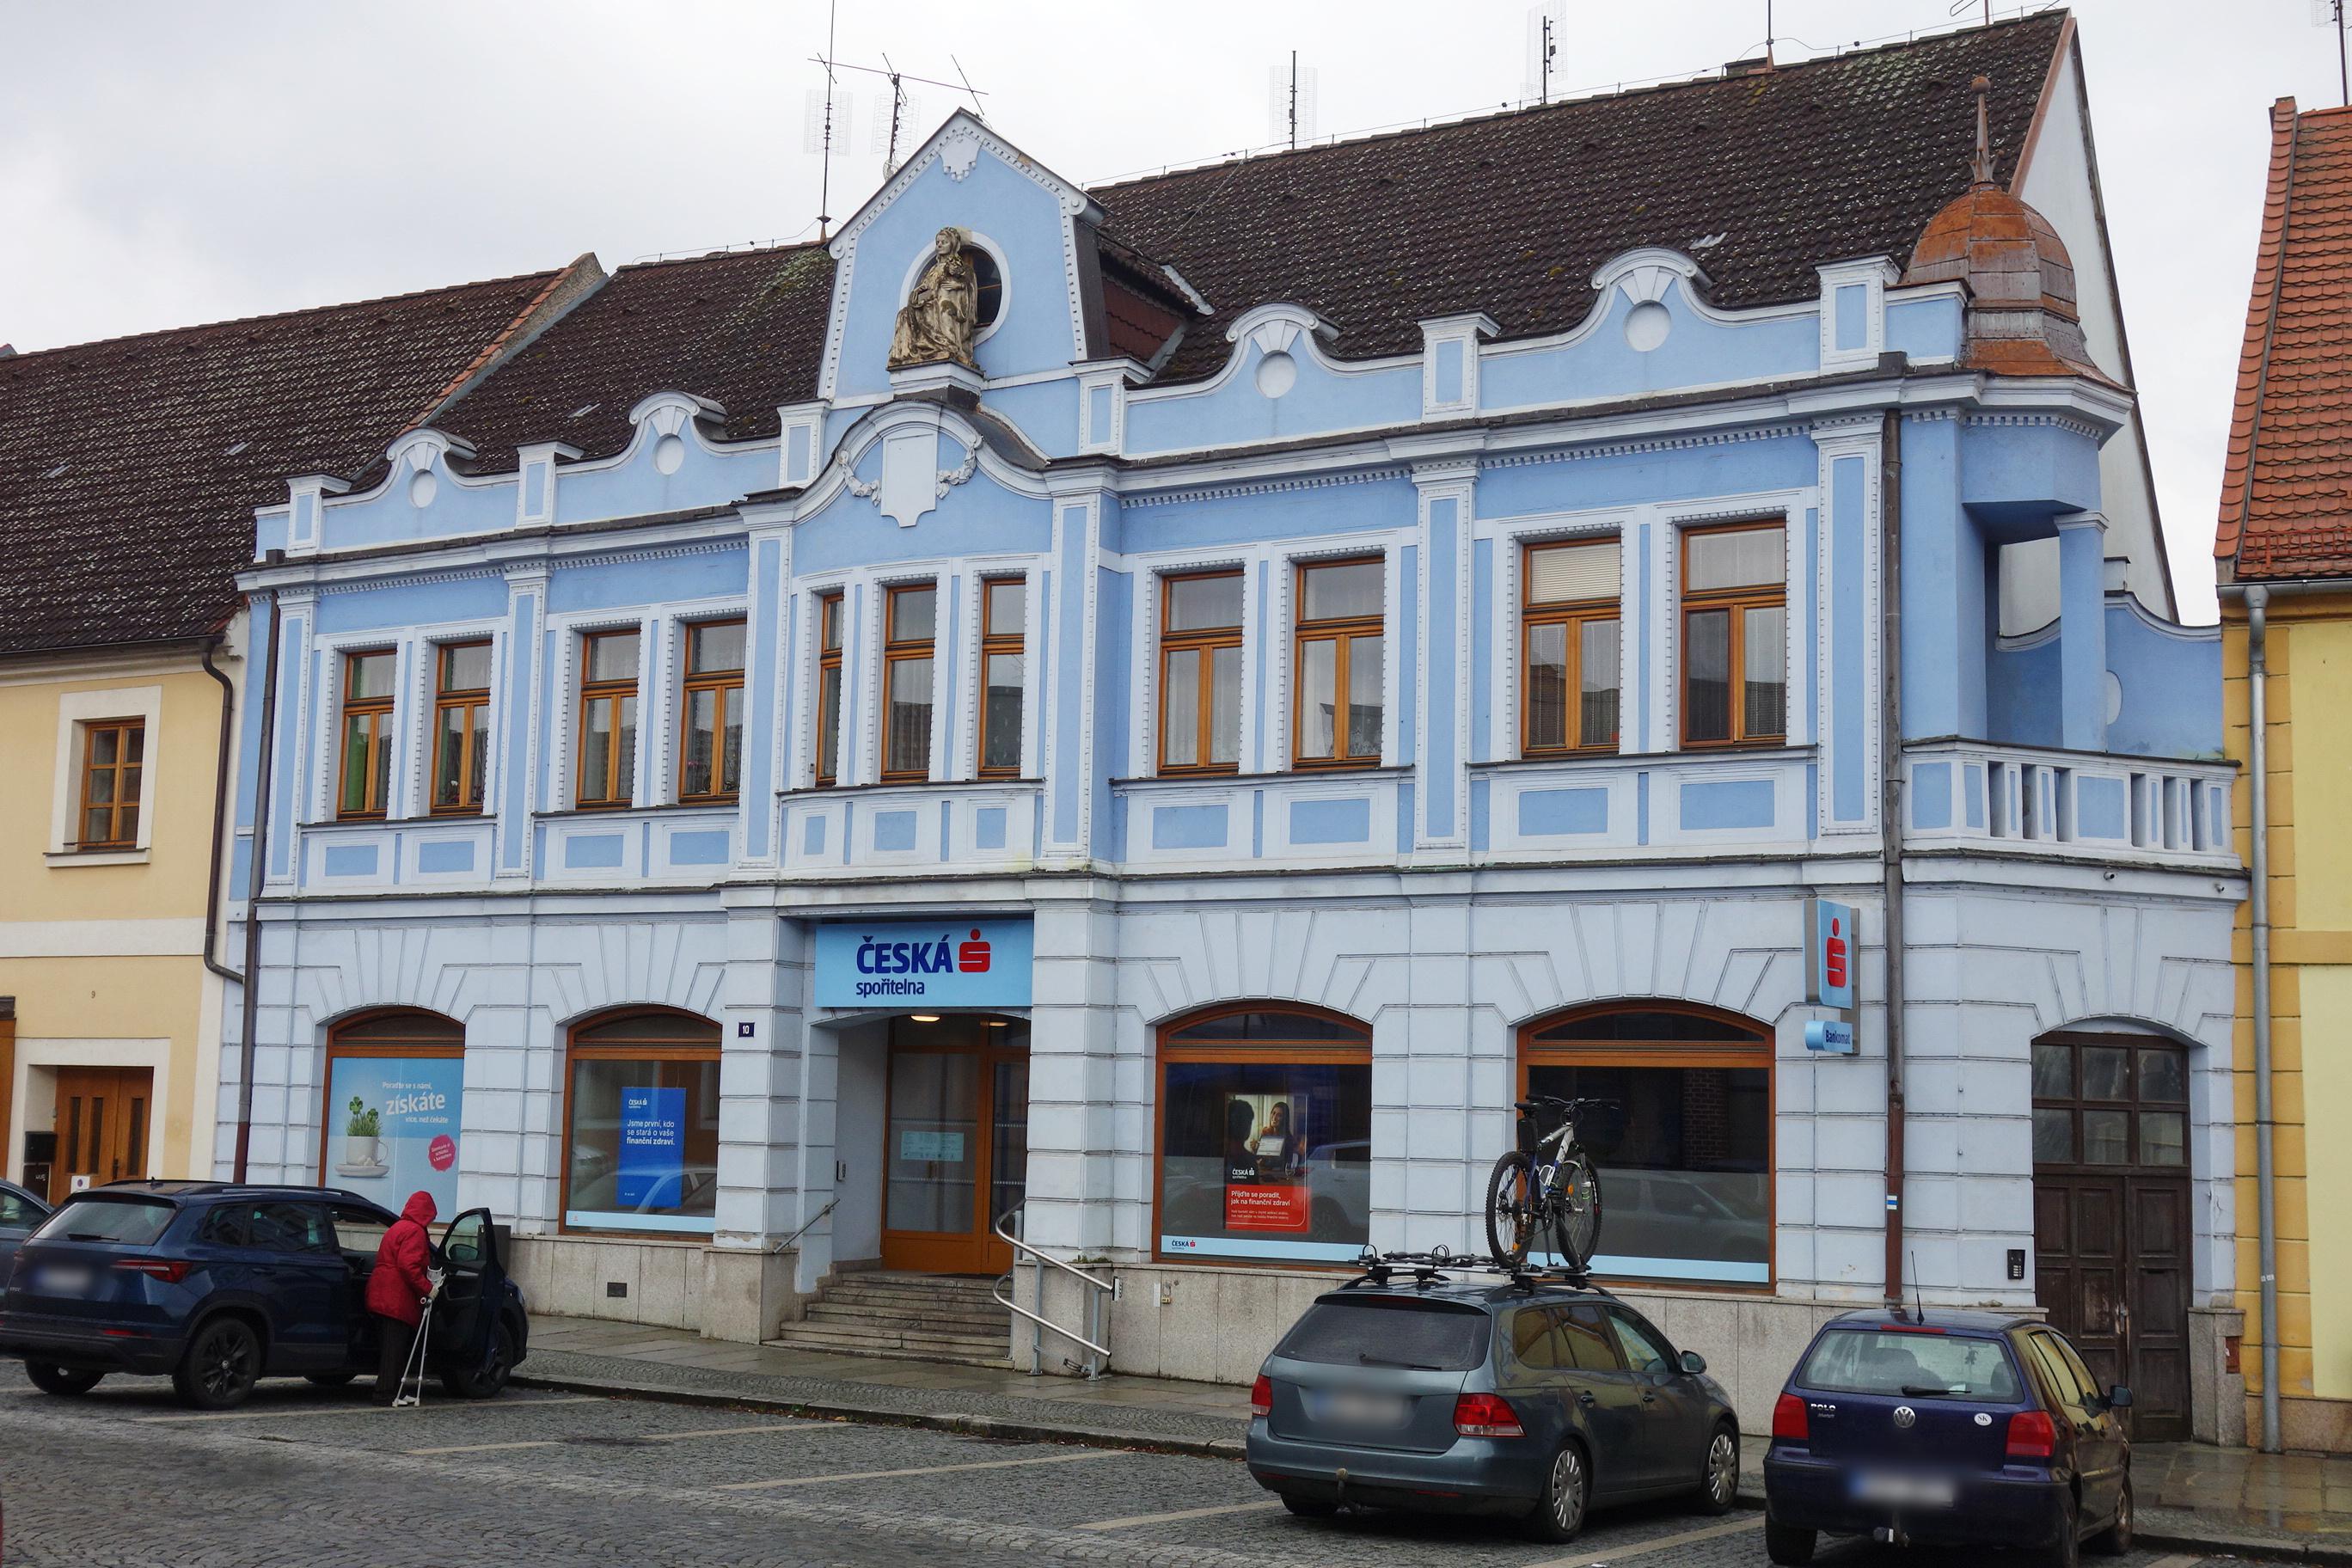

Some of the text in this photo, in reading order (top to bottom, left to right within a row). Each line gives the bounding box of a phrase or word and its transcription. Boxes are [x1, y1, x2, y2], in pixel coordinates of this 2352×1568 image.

[856, 934, 953, 974] ČESKÁ
[855, 978, 925, 998] spořitelna
[91, 990, 96, 999] 9
[742, 1025, 750, 1034] 10
[1825, 1029, 1851, 1045] Bankomat
[385, 1091, 446, 1116] získáte
[644, 1120, 662, 1129] první,
[626, 1136, 675, 1146] finanční zdraví.
[1810, 1403, 1836, 1412] POLO
